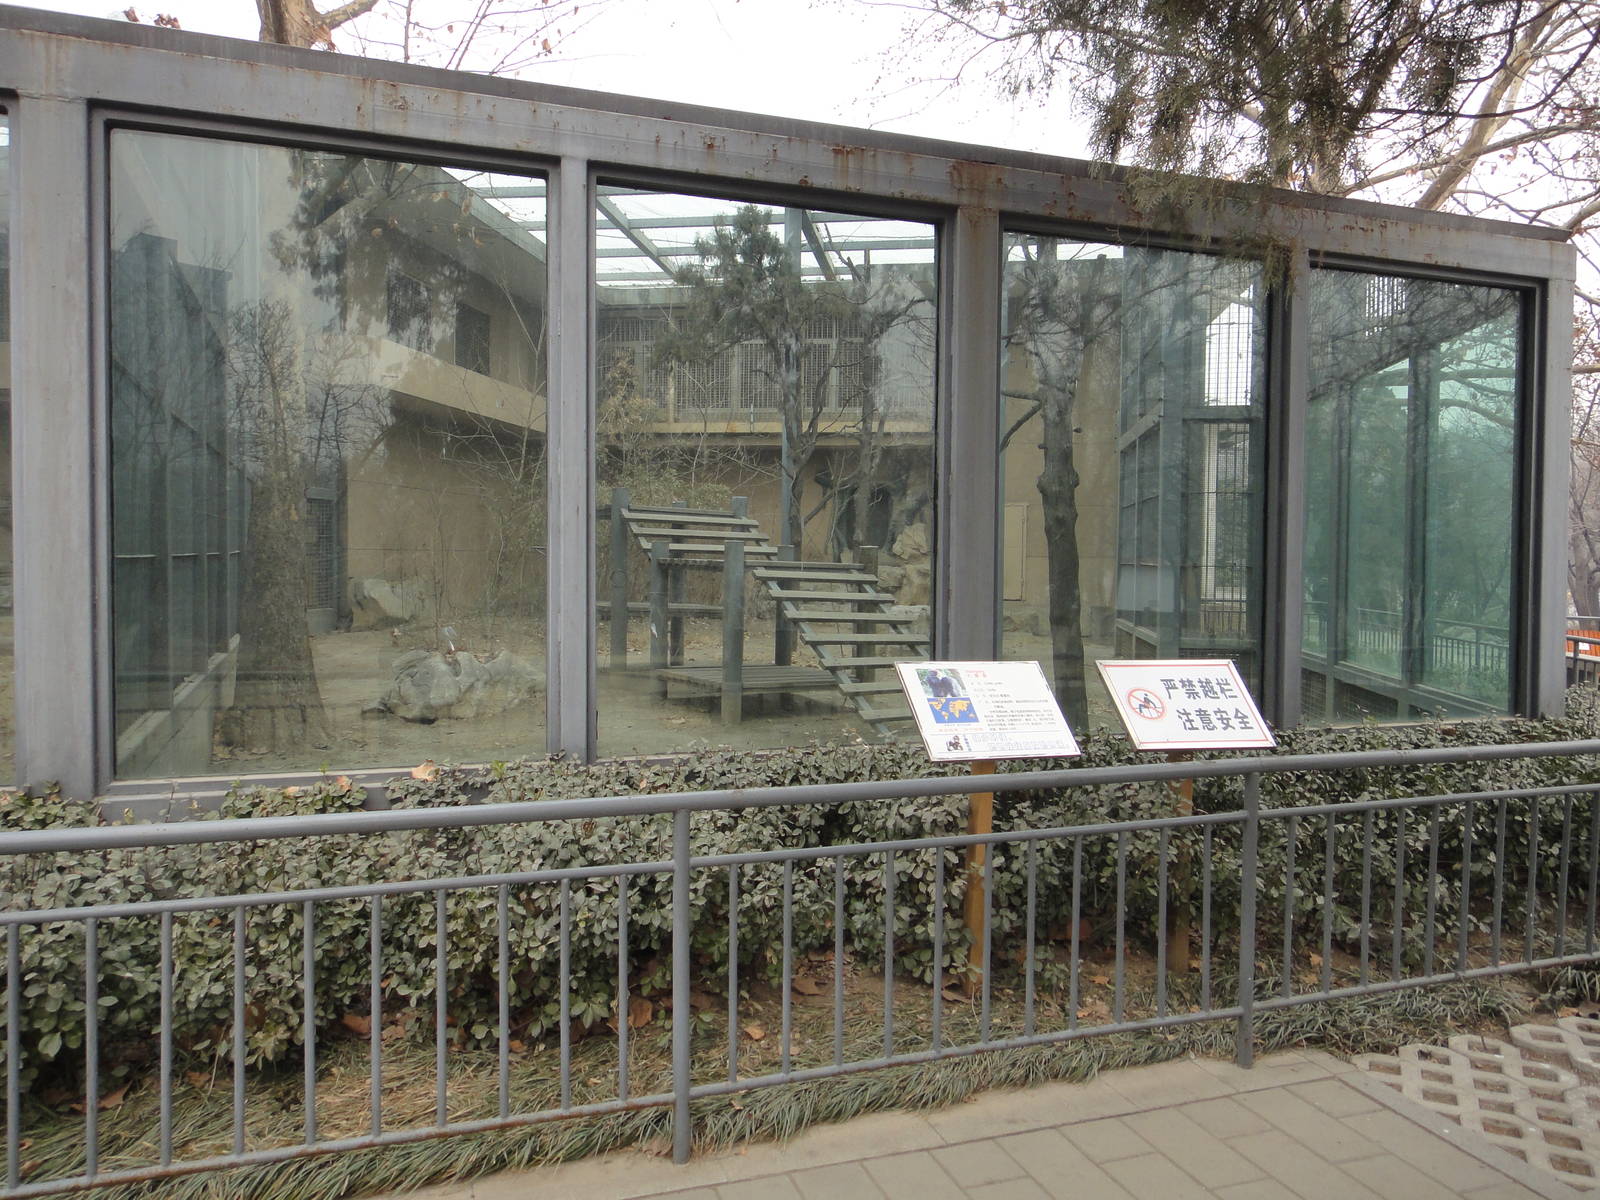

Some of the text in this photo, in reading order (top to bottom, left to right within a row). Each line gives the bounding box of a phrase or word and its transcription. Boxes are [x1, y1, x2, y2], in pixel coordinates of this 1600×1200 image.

[1160, 678, 1238, 700] 严禁越栏
[1176, 707, 1254, 731] 注意安全
